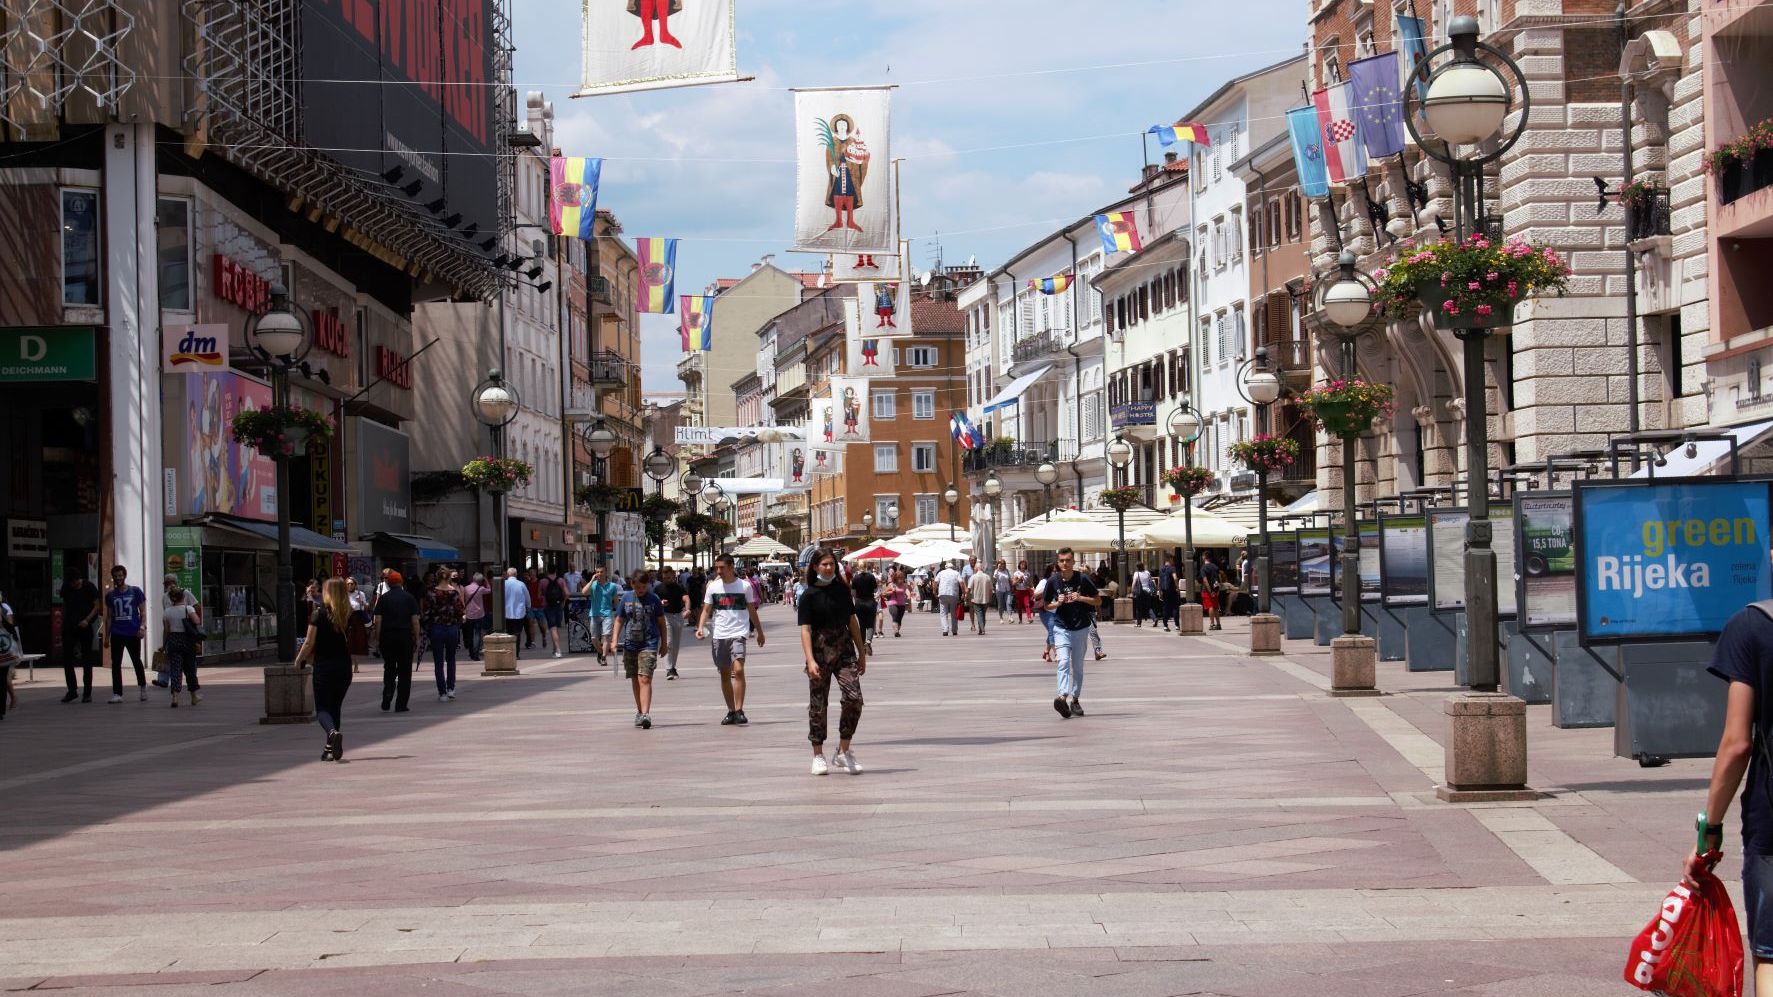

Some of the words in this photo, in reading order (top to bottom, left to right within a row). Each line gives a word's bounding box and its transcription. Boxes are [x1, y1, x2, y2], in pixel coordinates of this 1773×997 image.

[19, 336, 47, 361] D
[178, 331, 217, 353] dm
[1, 366, 67, 375] DEICHMANN
[676, 427, 713, 440] Klimt
[1533, 538, 1546, 550] 15,5
[1547, 538, 1567, 548] TONA
[1642, 518, 1756, 557] green
[1597, 554, 1710, 599] Rijeka
[1634, 879, 1691, 984] PLODI
